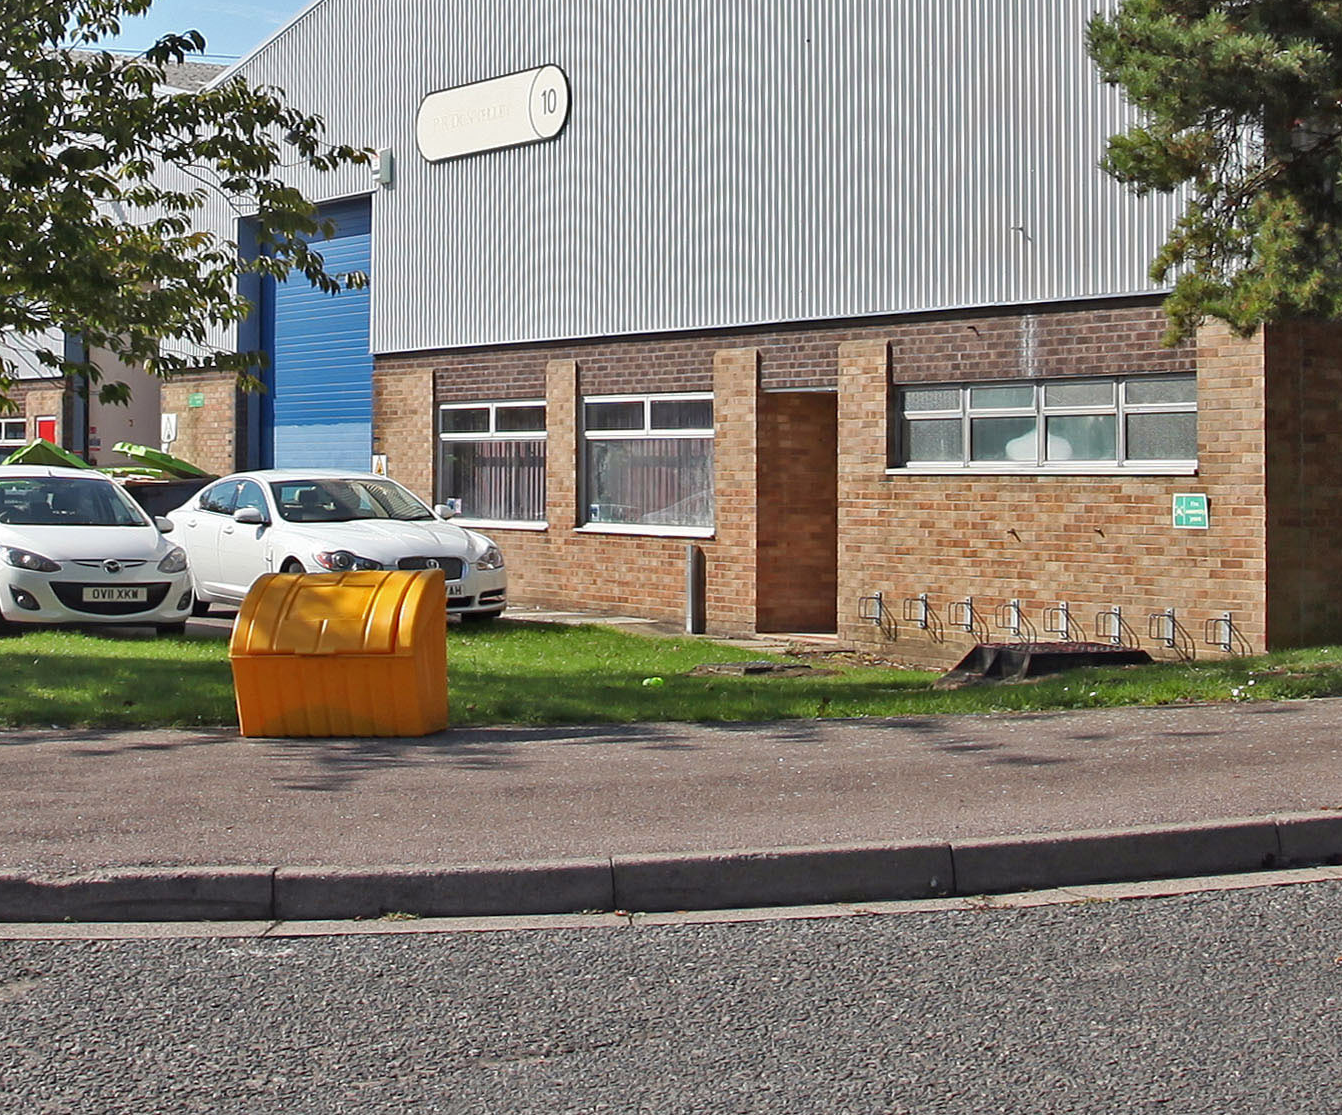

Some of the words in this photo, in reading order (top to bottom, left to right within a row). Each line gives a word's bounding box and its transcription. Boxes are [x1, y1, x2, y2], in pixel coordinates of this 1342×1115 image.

[541, 88, 557, 115] 10
[117, 589, 138, 599] XKW
[446, 586, 462, 595] AH
